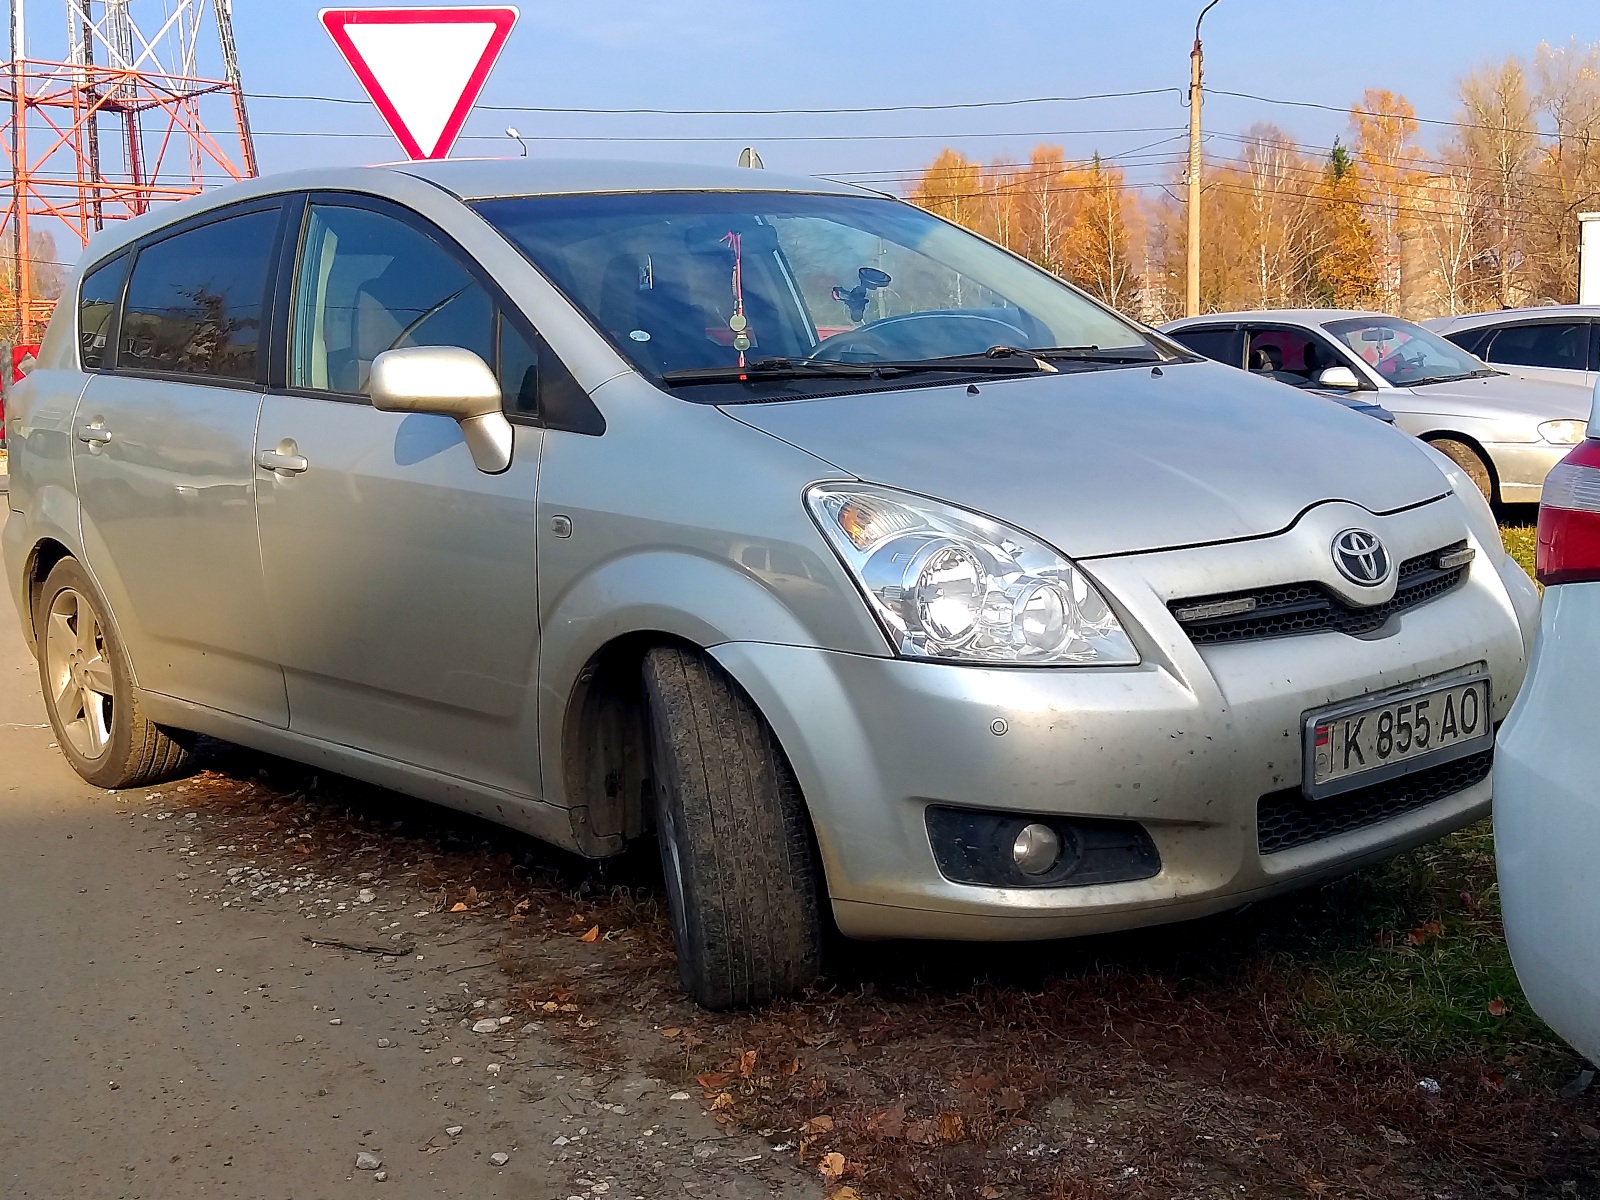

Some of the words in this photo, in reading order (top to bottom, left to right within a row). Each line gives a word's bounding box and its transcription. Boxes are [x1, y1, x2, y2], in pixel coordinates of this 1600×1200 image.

[1343, 716, 1366, 770] K
[1376, 700, 1430, 760] 855
[1440, 687, 1479, 743] AO
